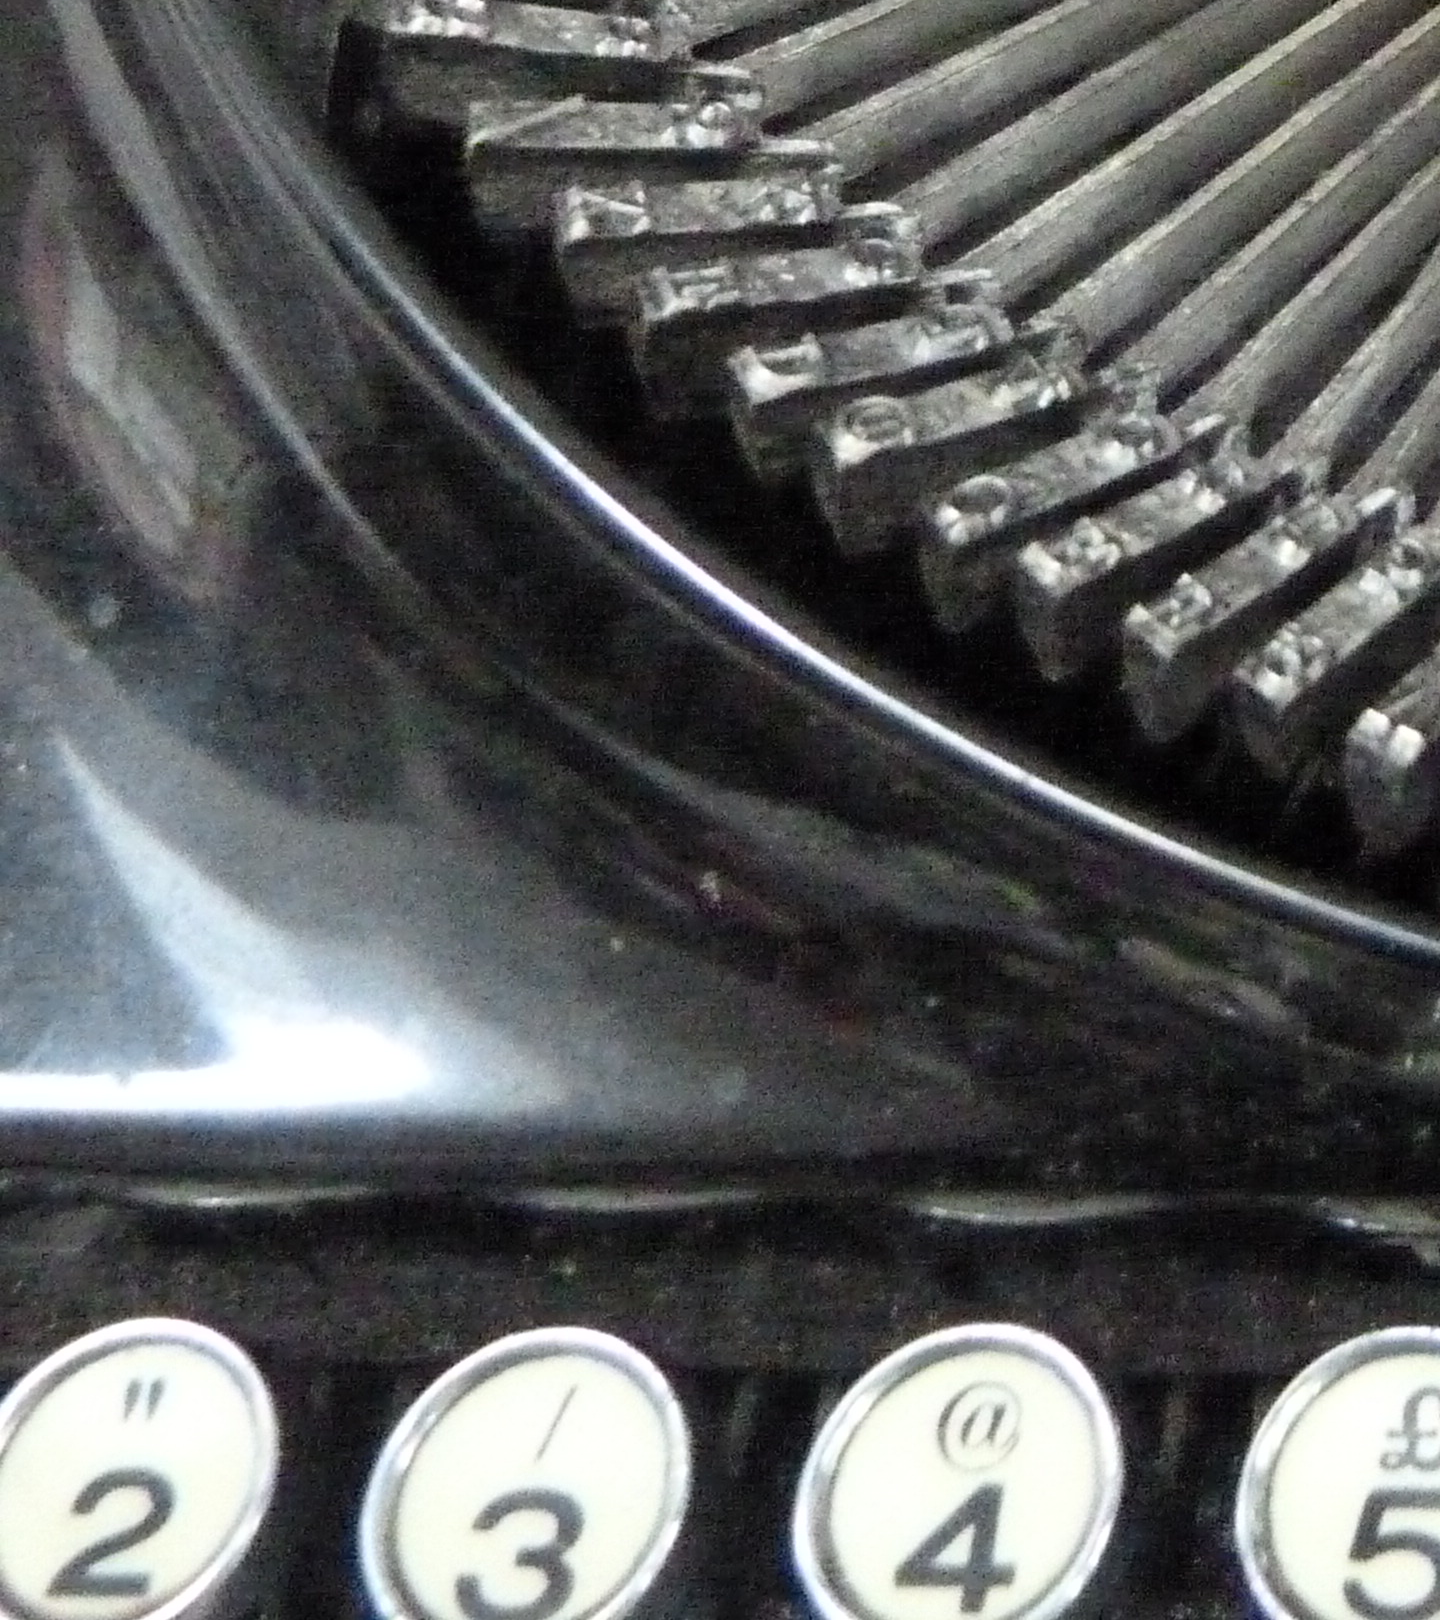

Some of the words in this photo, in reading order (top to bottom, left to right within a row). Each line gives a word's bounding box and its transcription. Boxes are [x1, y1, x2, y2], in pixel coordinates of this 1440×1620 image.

[124, 1378, 165, 1421] "
[534, 1382, 579, 1464] /
[936, 1384, 1023, 1471] @
[46, 1469, 174, 1596] 2
[455, 1490, 586, 1620] 3
[894, 1483, 1015, 1612] 4
